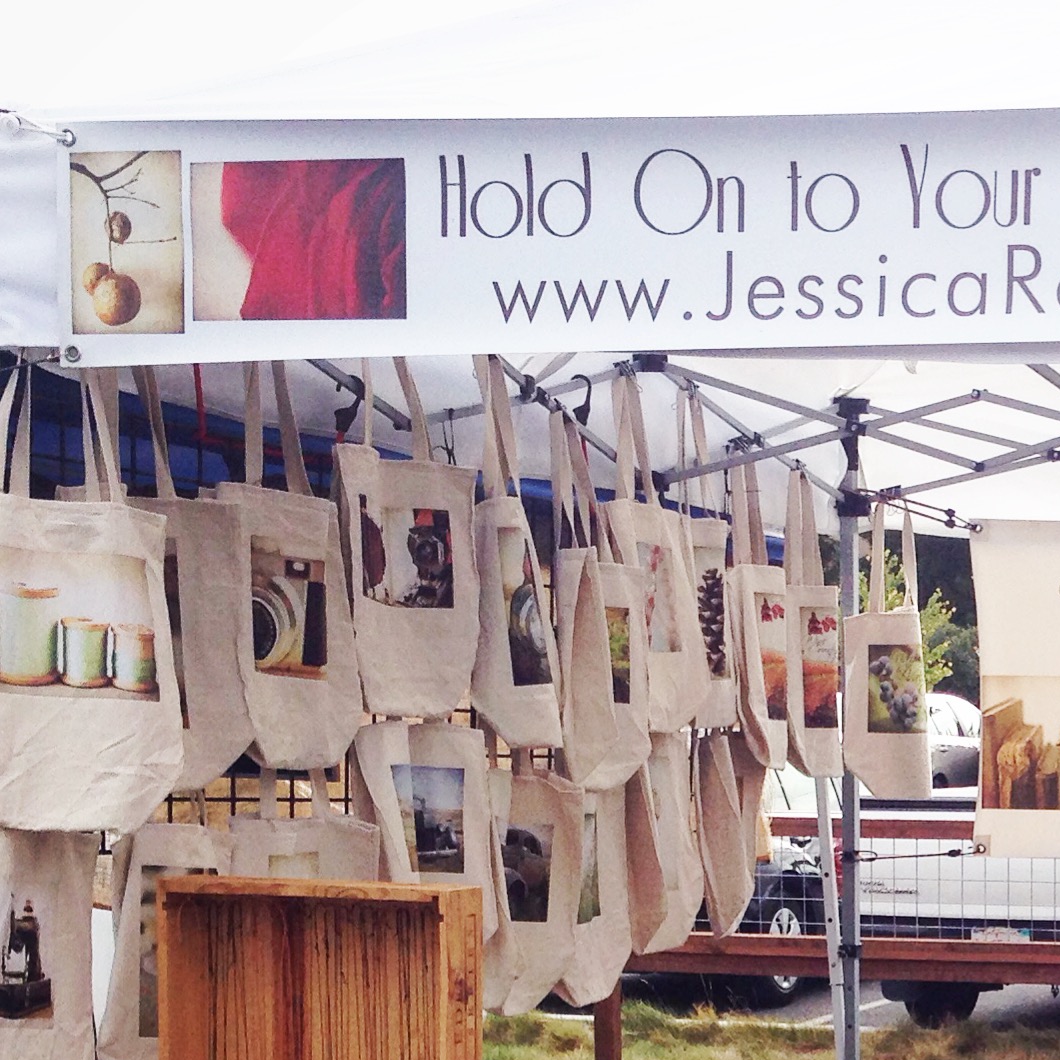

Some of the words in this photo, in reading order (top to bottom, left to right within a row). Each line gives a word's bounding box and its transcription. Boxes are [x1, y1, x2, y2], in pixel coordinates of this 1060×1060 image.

[439, 152, 591, 238] Hold
[634, 149, 745, 235] On
[787, 161, 860, 232] to
[900, 143, 1041, 229] Your
